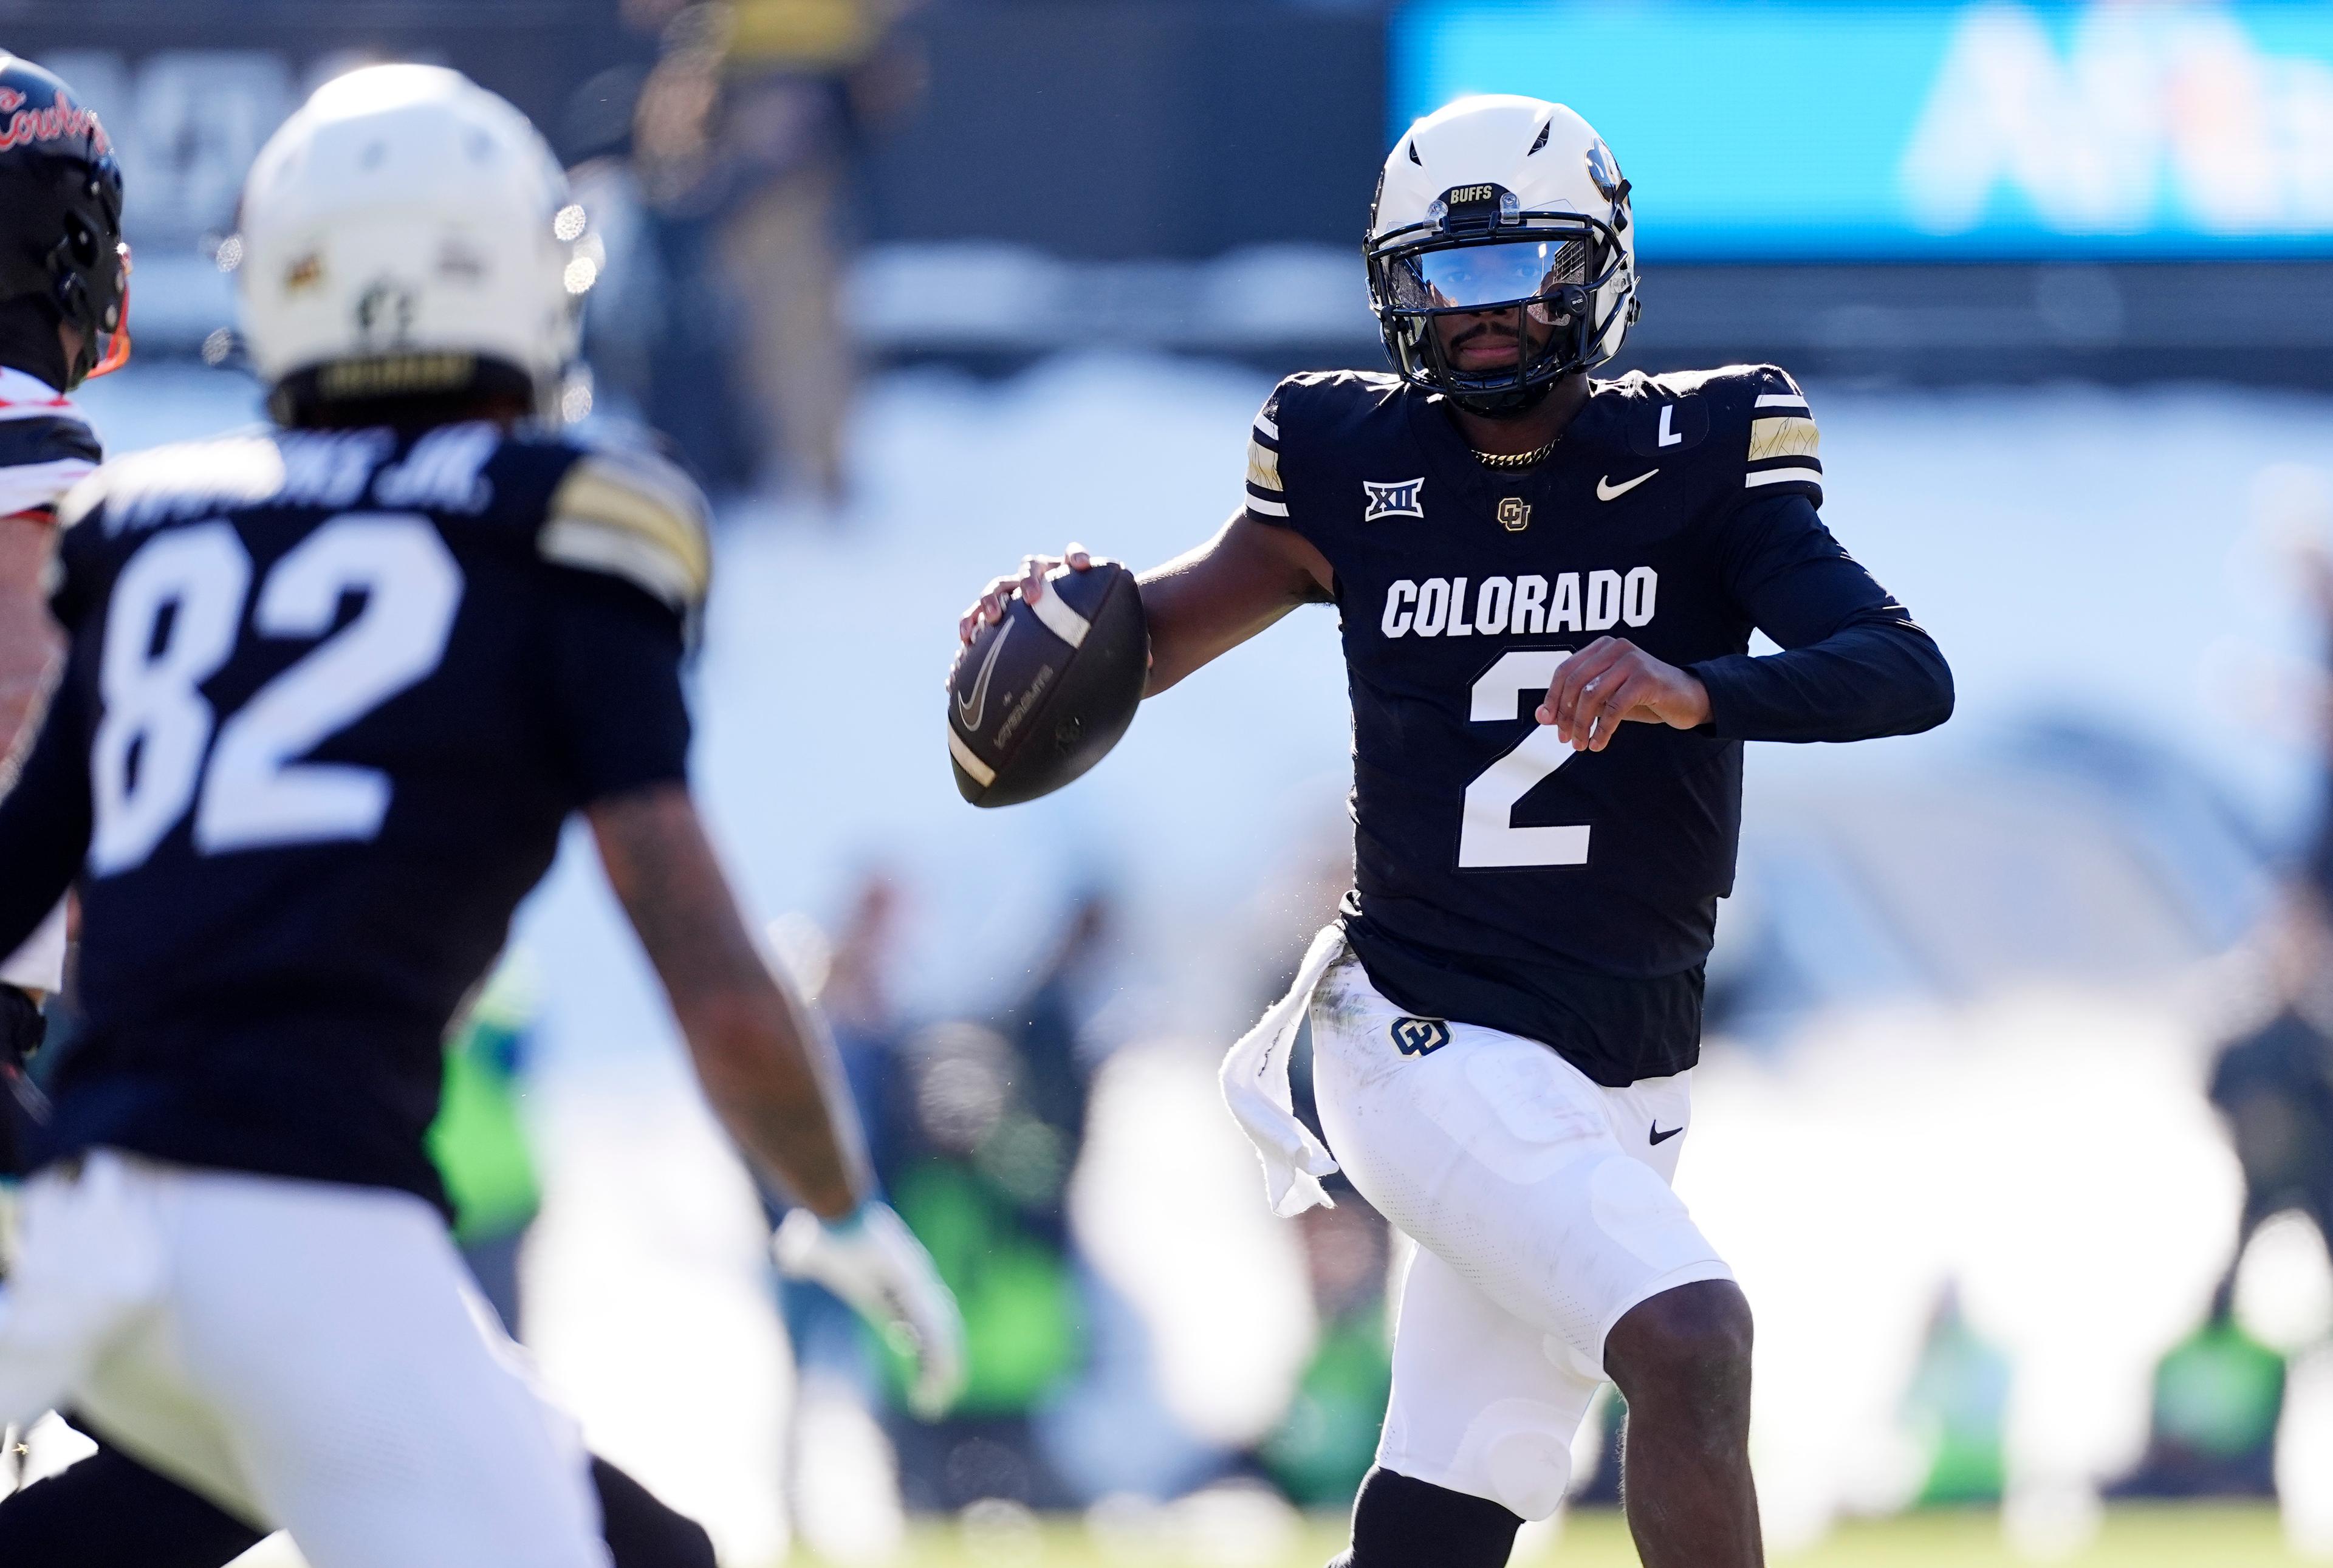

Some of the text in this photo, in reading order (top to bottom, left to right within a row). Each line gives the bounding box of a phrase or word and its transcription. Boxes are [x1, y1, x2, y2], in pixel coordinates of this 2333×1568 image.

[1450, 185, 1492, 204] BUFFS
[1659, 405, 1682, 447] L
[1367, 481, 1419, 518] XII
[1381, 566, 1658, 639] COLORADO
[87, 511, 467, 879] 82
[1458, 650, 1599, 868] 2
